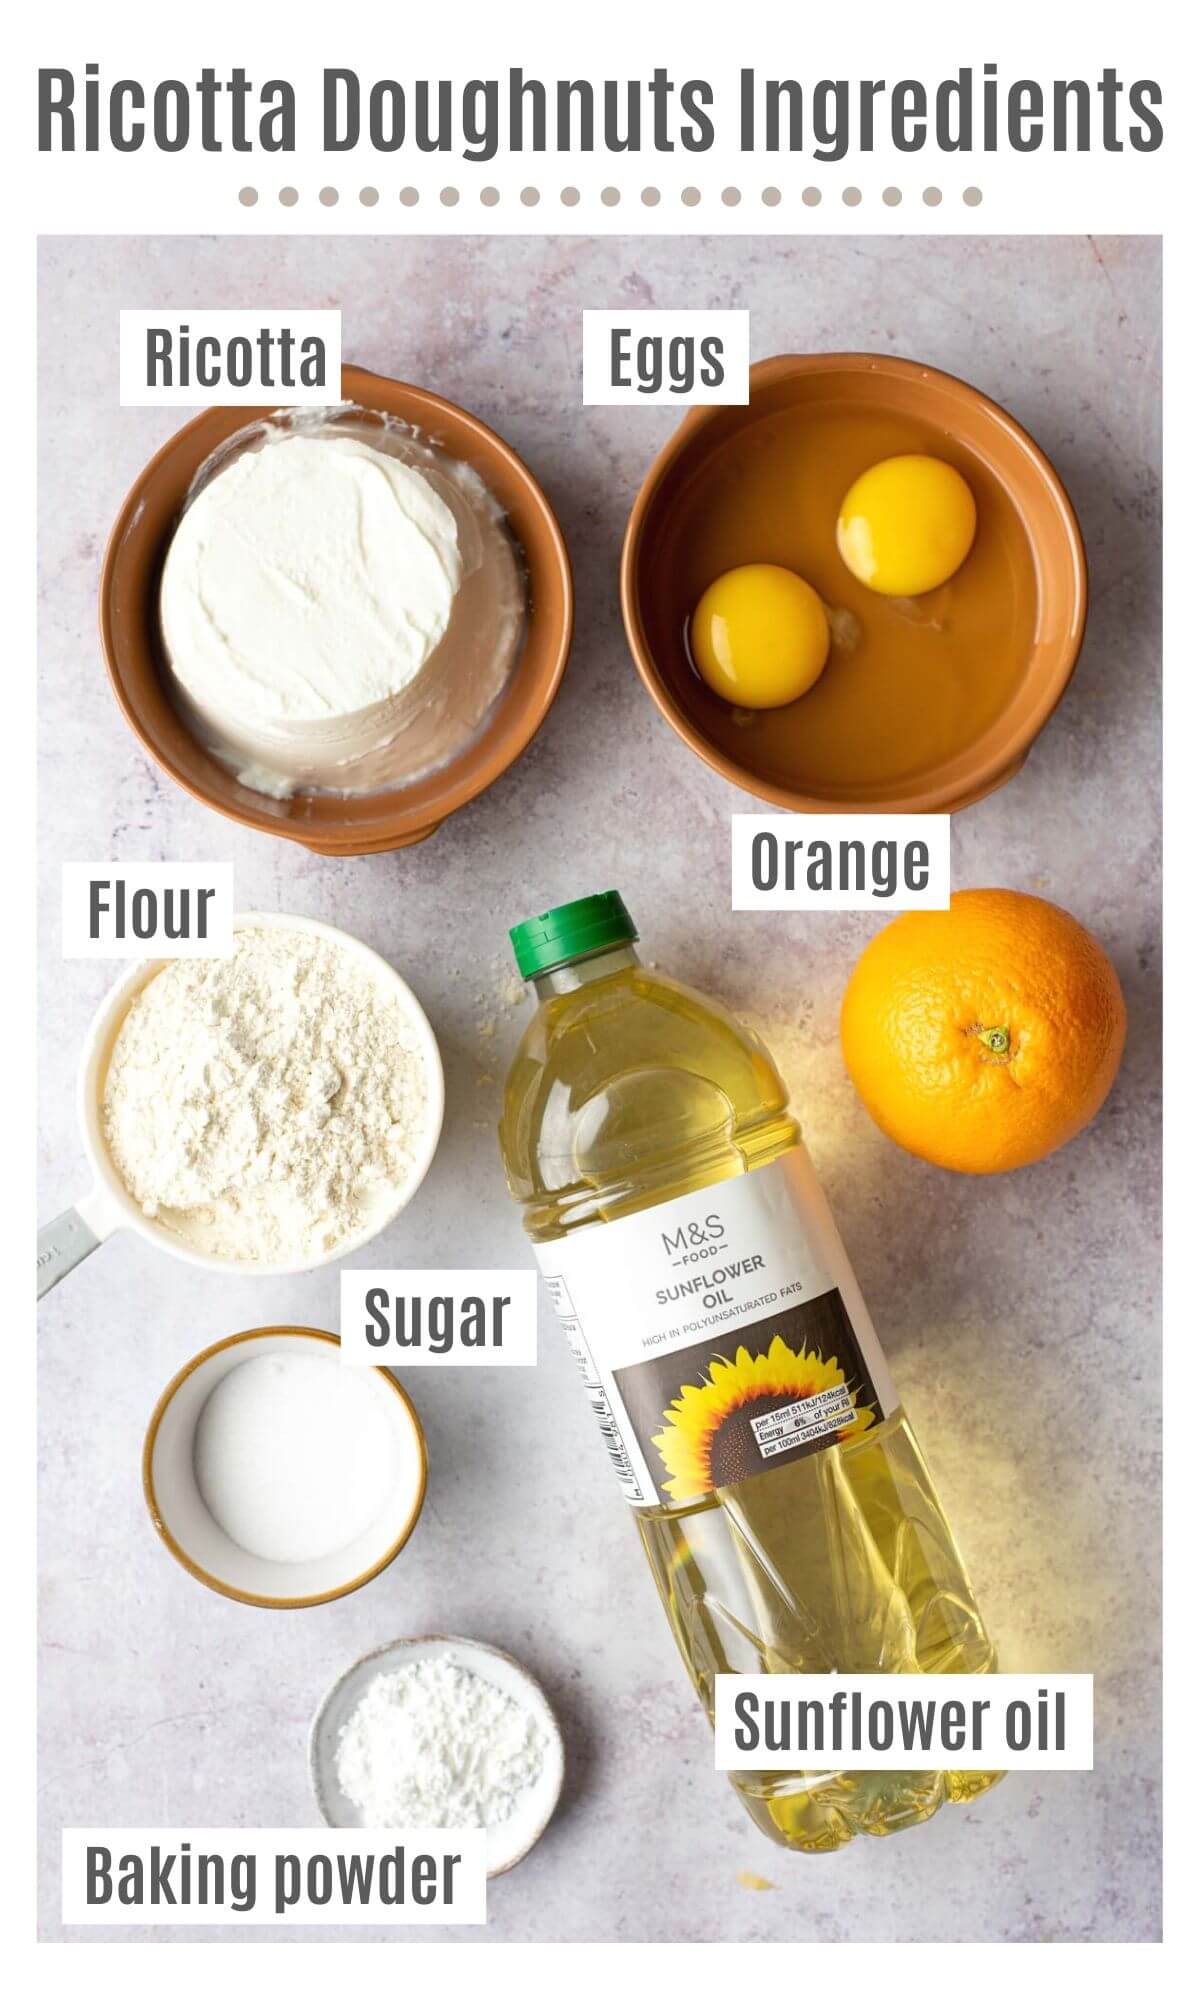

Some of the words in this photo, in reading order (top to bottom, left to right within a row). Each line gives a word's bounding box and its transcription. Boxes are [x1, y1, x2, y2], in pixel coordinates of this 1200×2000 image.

[661, 1214, 725, 1256] M&S
[682, 1245, 719, 1266] FOOD
[656, 1254, 766, 1305] SUNFLOWER
[702, 1289, 734, 1309] OIL
[642, 1332, 667, 1348] HIGH
[669, 1328, 680, 1339] IN
[683, 1292, 778, 1334] POLYUNSATURATED
[780, 1281, 803, 1298] FATS
[755, 1418, 769, 1431] per
[771, 1410, 791, 1423] 15ml
[760, 1426, 784, 1441] Energy
[814, 1410, 823, 1420] of
[823, 1404, 841, 1418] your
[764, 1445, 777, 1456] per
[778, 1435, 800, 1449] 100ml
